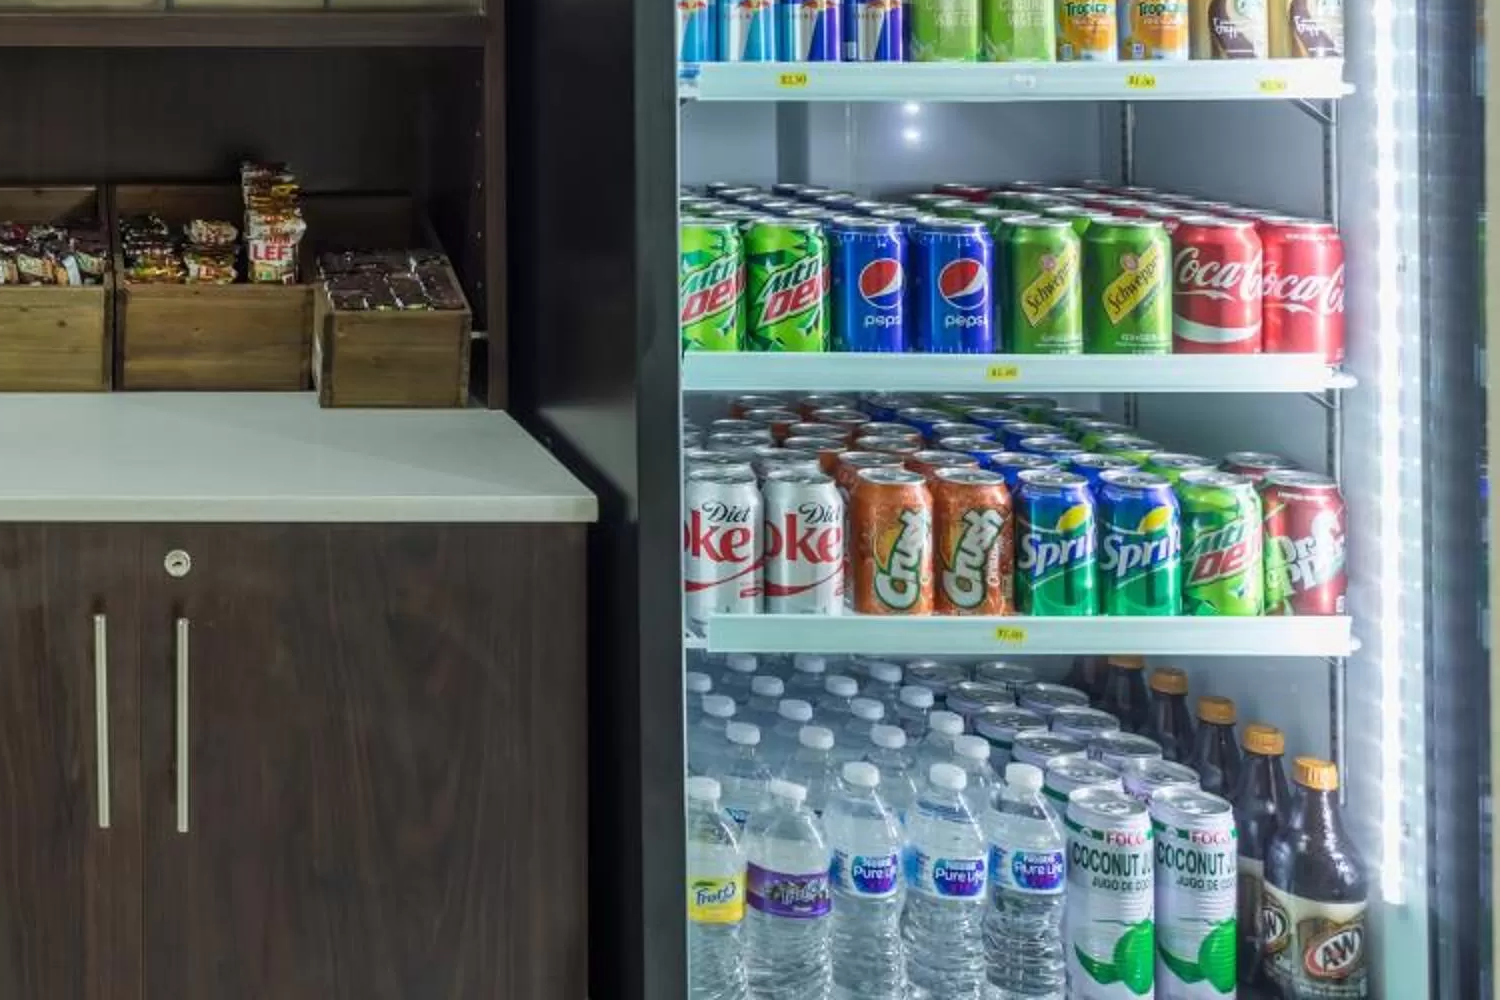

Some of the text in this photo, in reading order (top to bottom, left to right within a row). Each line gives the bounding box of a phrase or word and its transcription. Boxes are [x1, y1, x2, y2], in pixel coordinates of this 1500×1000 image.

[863, 315, 901, 328] peps
[702, 502, 751, 523] Diet
[1073, 841, 1139, 877] COCONUT
[1156, 841, 1225, 877] COCONUT
[853, 864, 883, 881] Pure
[934, 867, 965, 883] Pure
